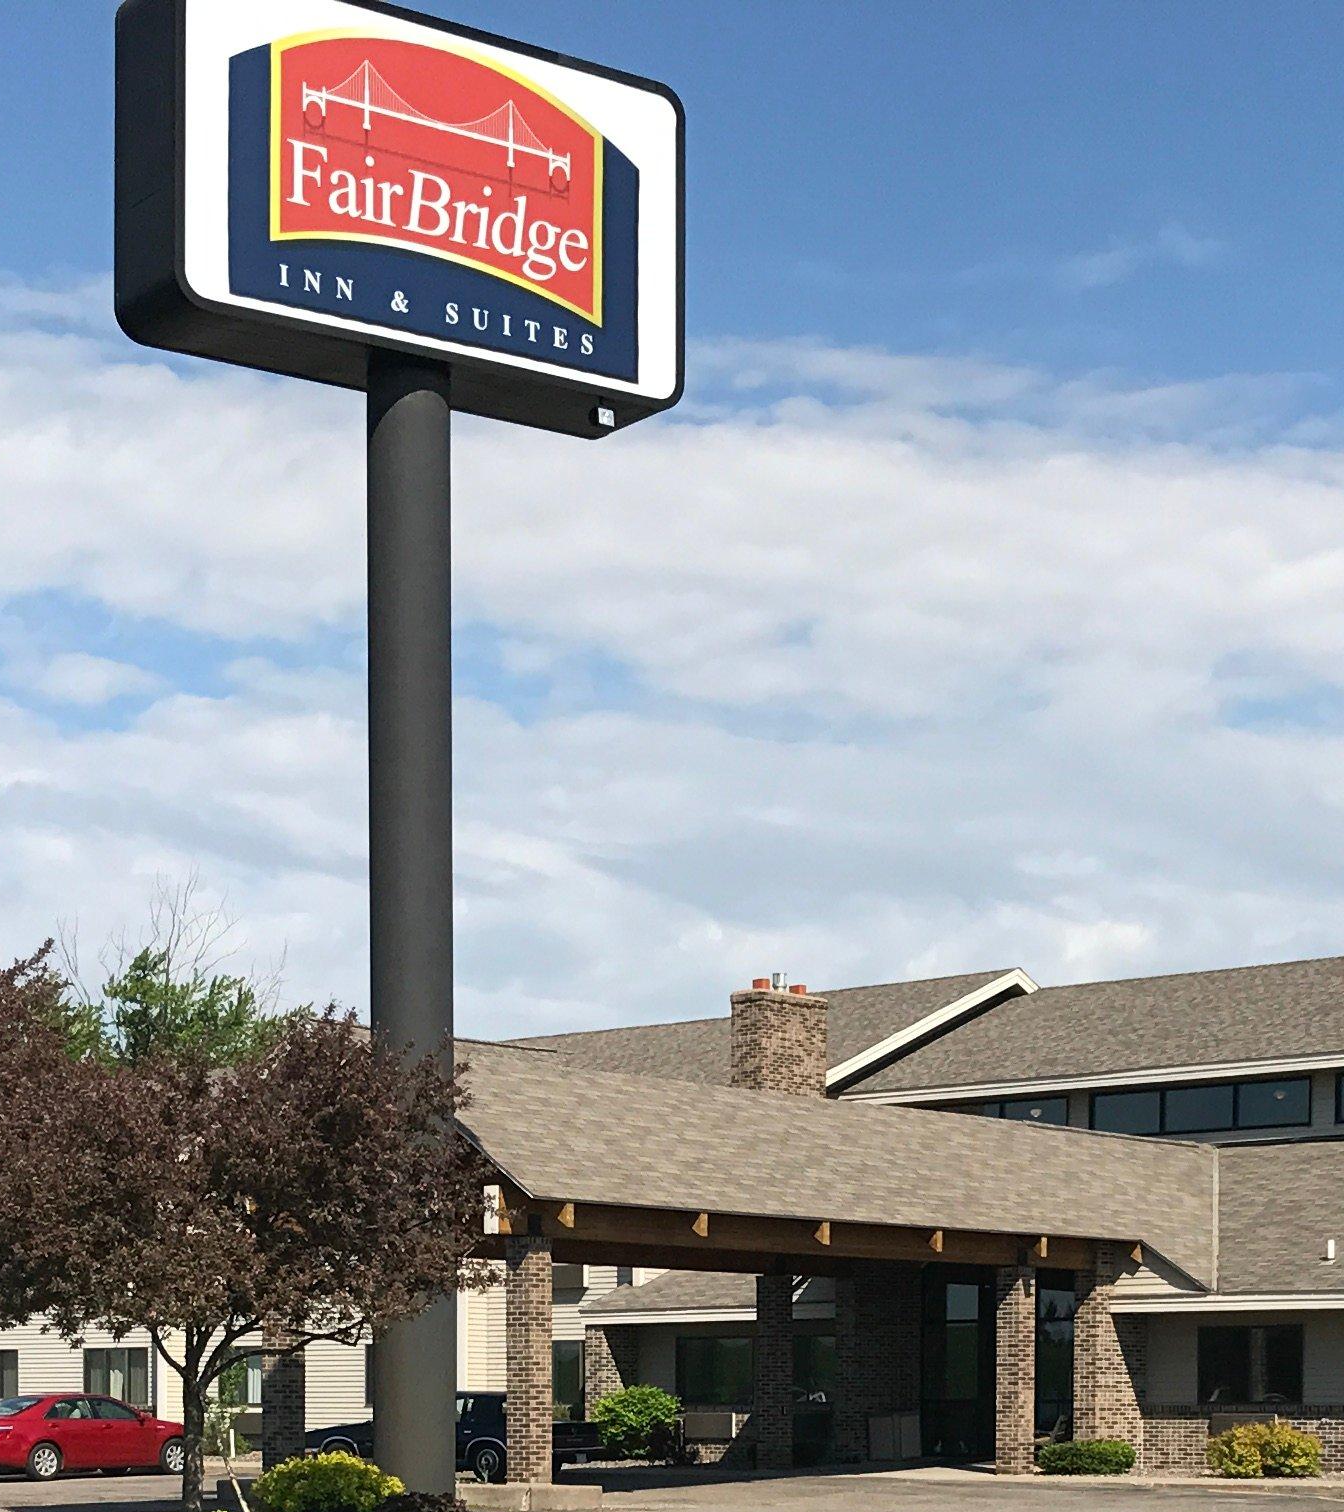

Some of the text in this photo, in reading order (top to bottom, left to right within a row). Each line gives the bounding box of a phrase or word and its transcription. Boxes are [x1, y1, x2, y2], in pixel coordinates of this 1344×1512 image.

[286, 138, 589, 281] FairBridge
[279, 264, 594, 355] INN & SUITES
